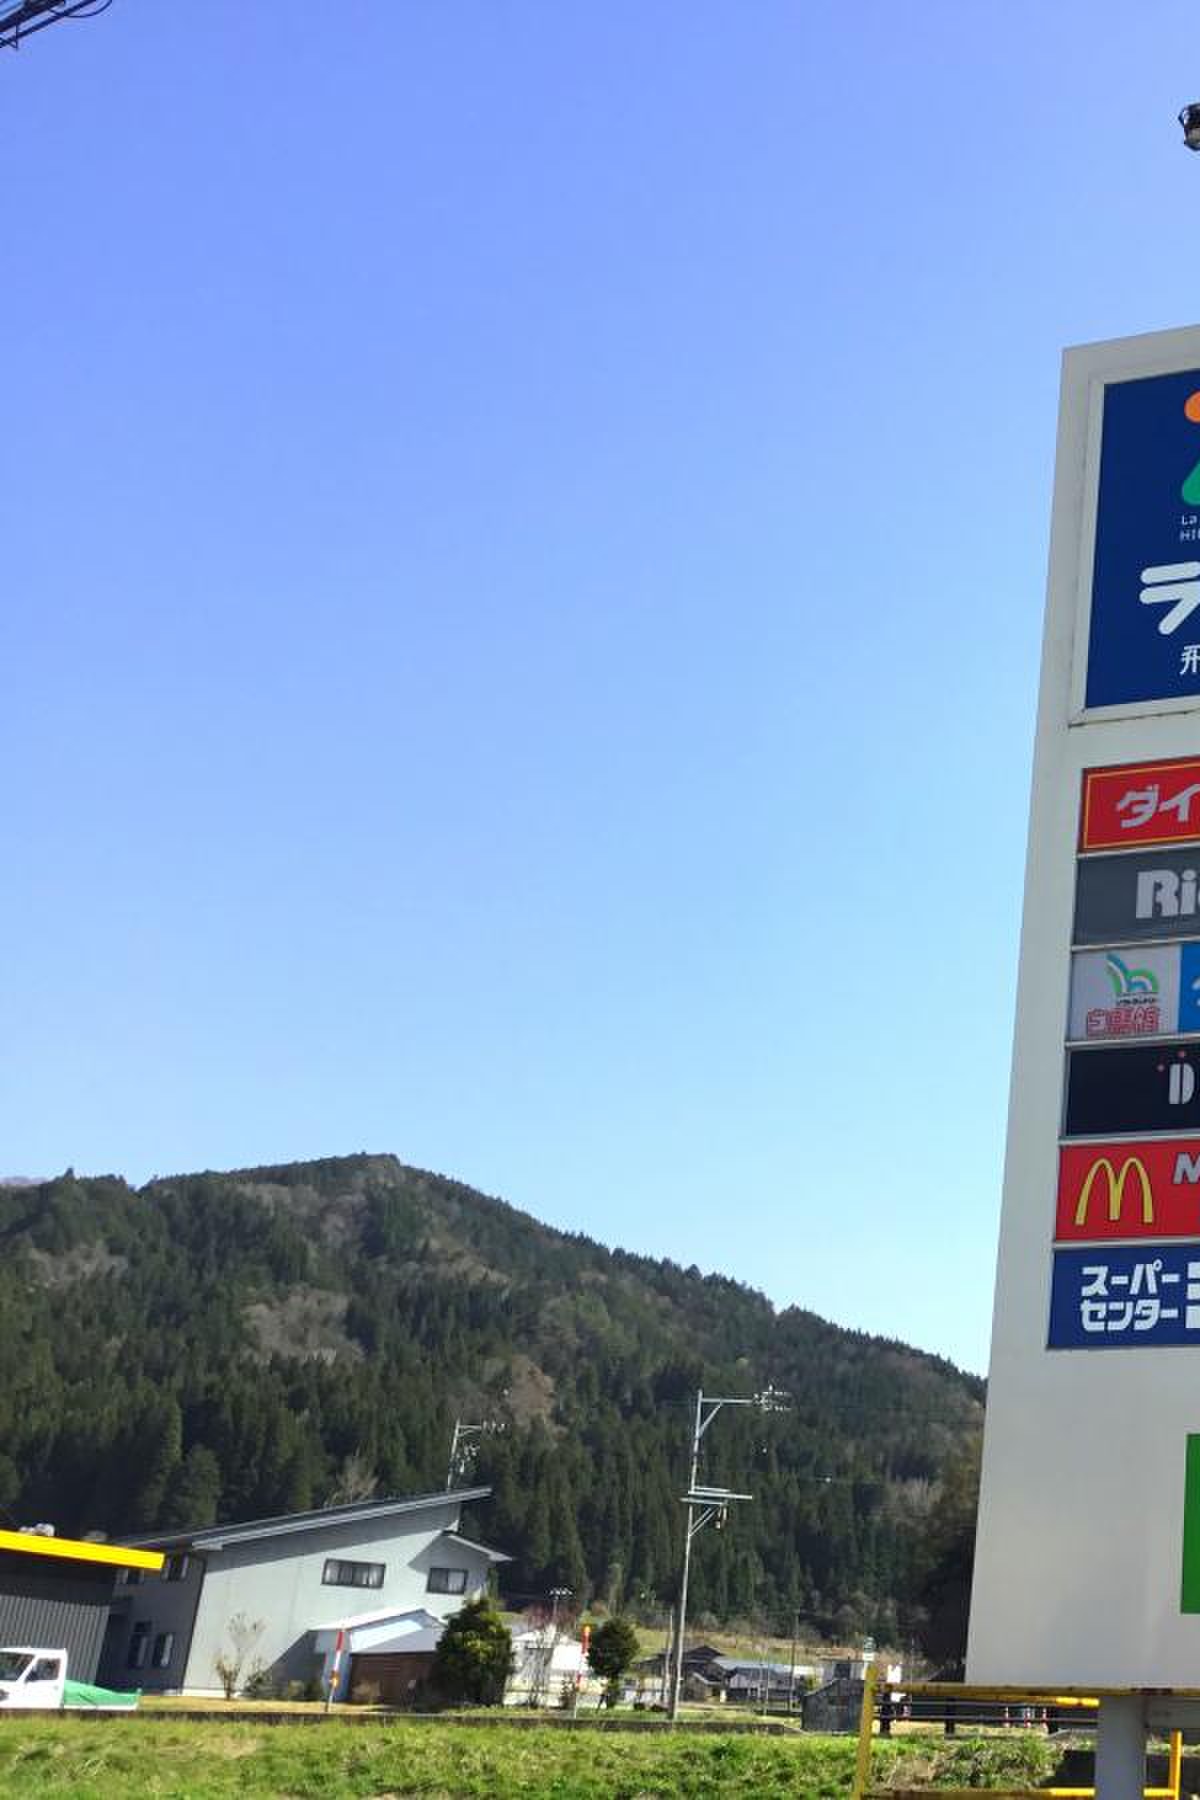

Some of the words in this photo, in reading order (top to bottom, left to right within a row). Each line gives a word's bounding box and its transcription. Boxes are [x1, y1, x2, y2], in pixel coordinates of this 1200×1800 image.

[1181, 515, 1198, 526] La
[1081, 1259, 1182, 1298] スーパー
[1080, 1299, 1179, 1333] センター
